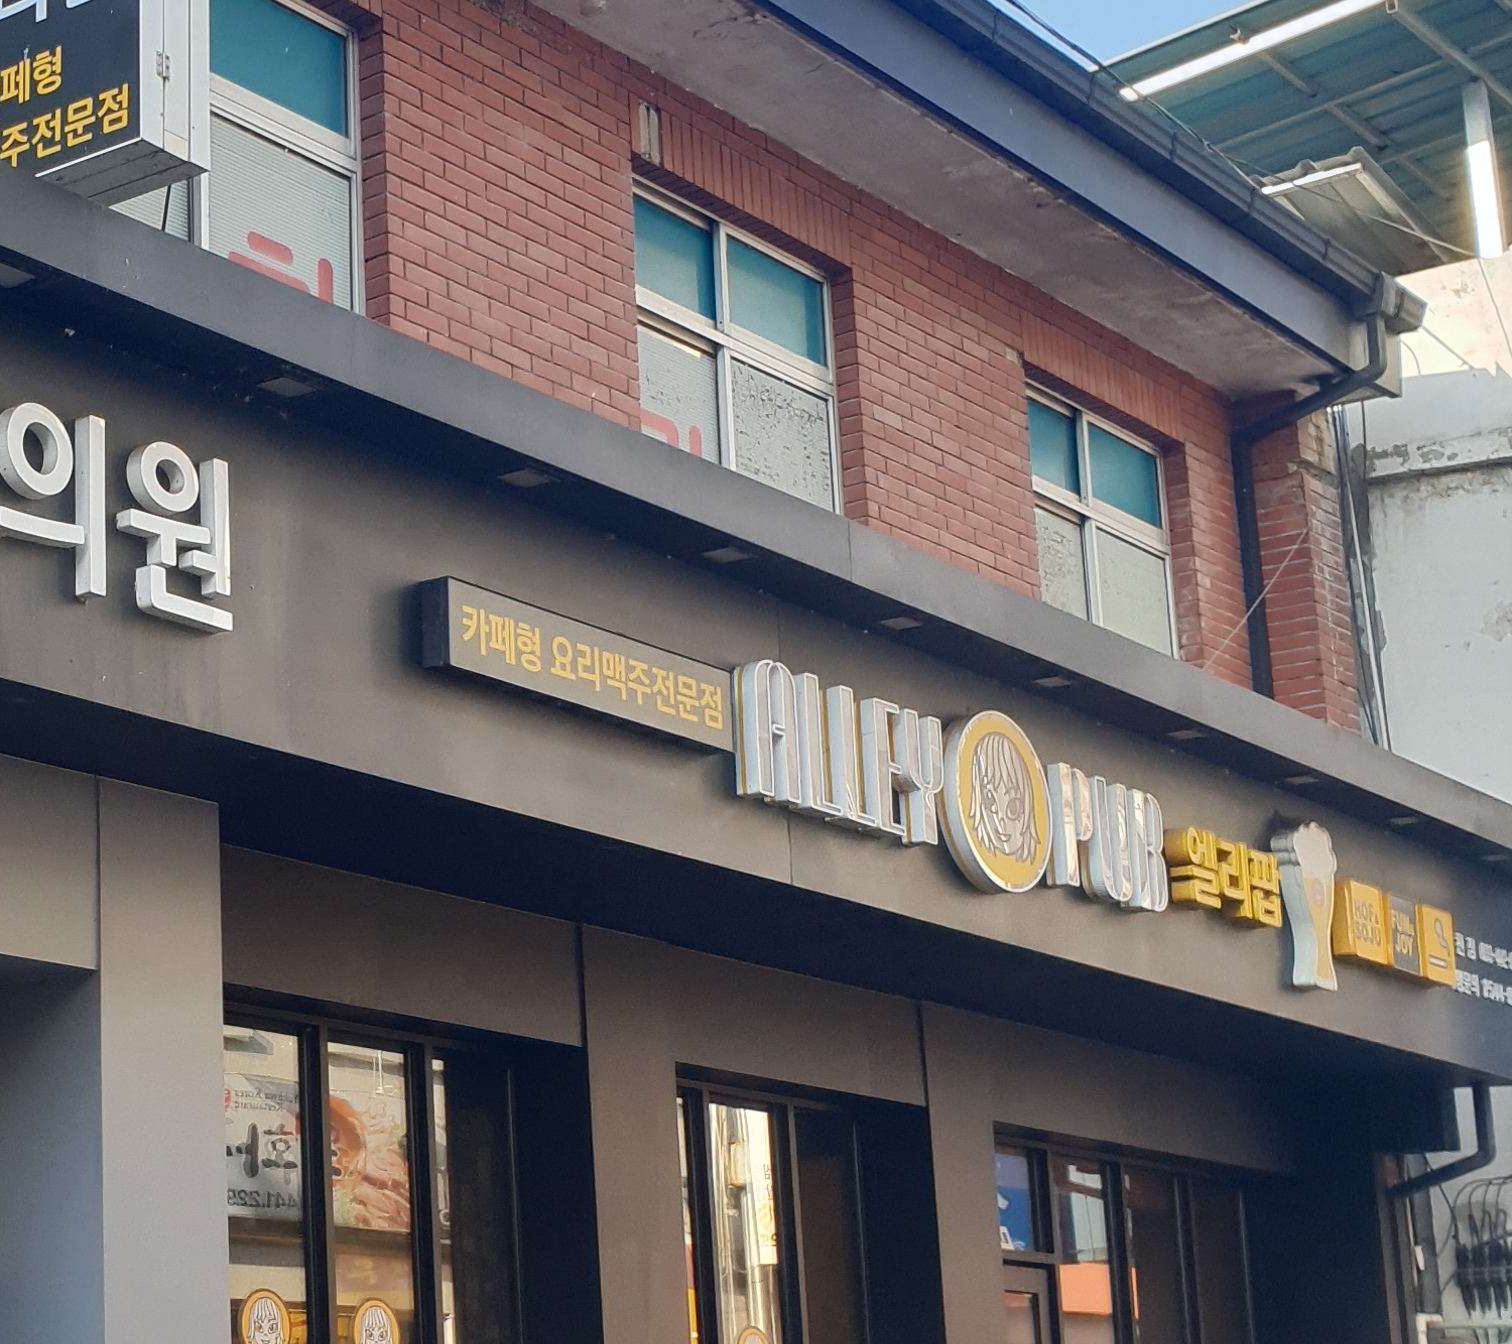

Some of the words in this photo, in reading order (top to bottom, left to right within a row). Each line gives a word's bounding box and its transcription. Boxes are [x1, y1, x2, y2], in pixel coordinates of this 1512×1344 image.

[461, 605, 543, 673] 카페형
[550, 636, 724, 730] 요리맥주전문점
[1046, 762, 1169, 912] PUB
